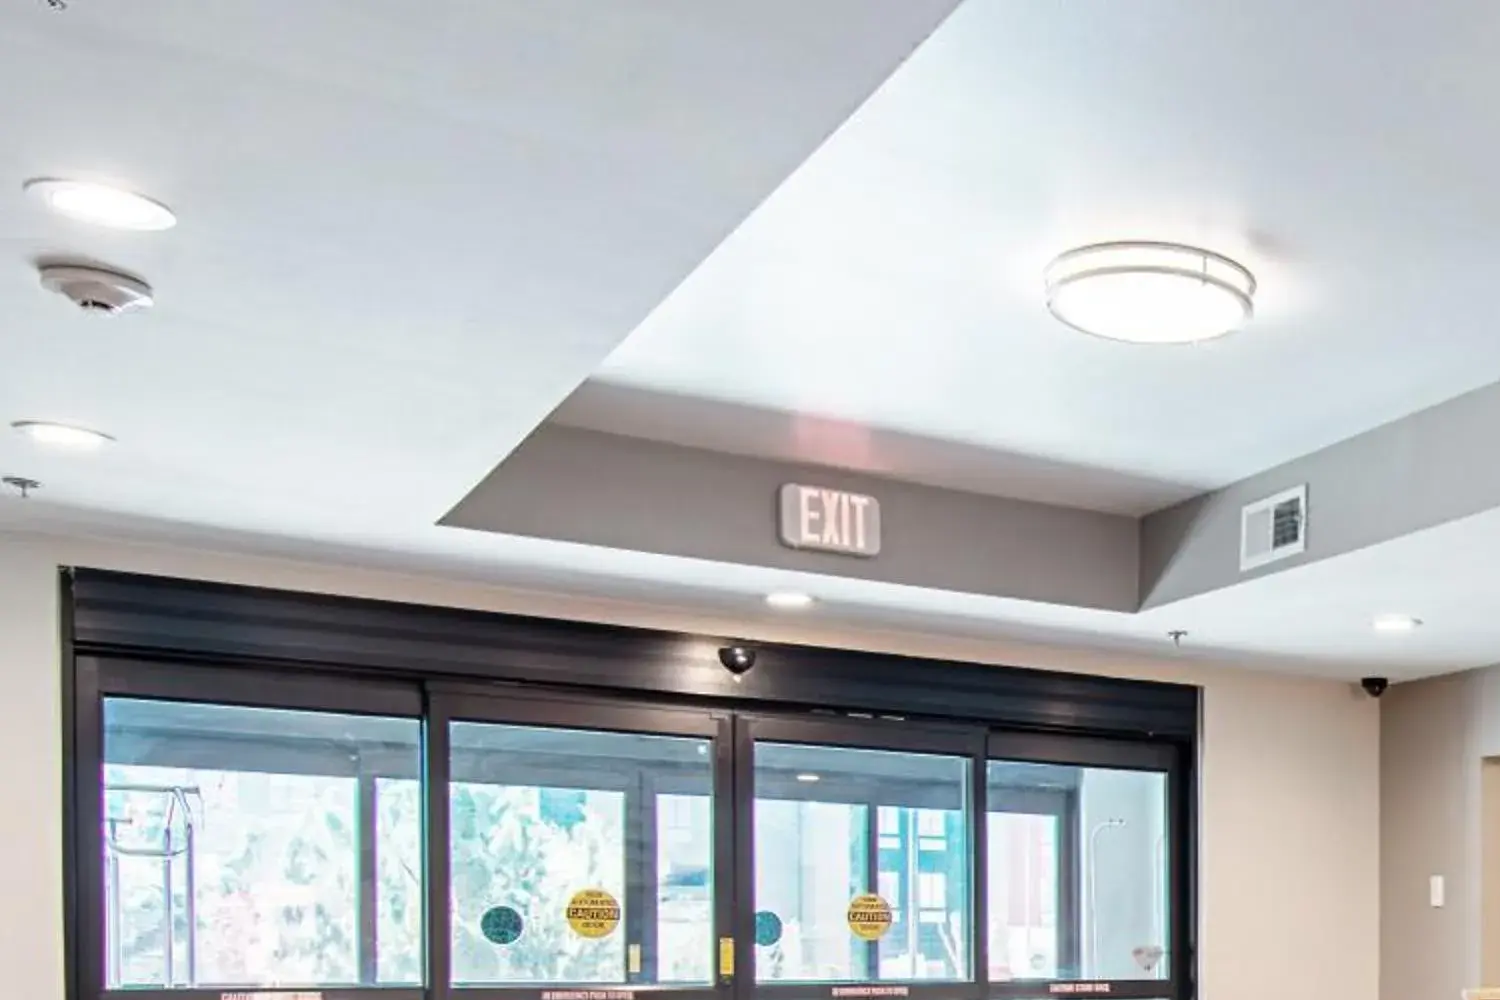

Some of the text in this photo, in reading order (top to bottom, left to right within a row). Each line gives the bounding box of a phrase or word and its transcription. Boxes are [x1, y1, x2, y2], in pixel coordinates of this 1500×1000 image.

[800, 486, 869, 549] EXIT
[569, 908, 619, 919] CAUTION
[849, 911, 890, 922] CAUTION
